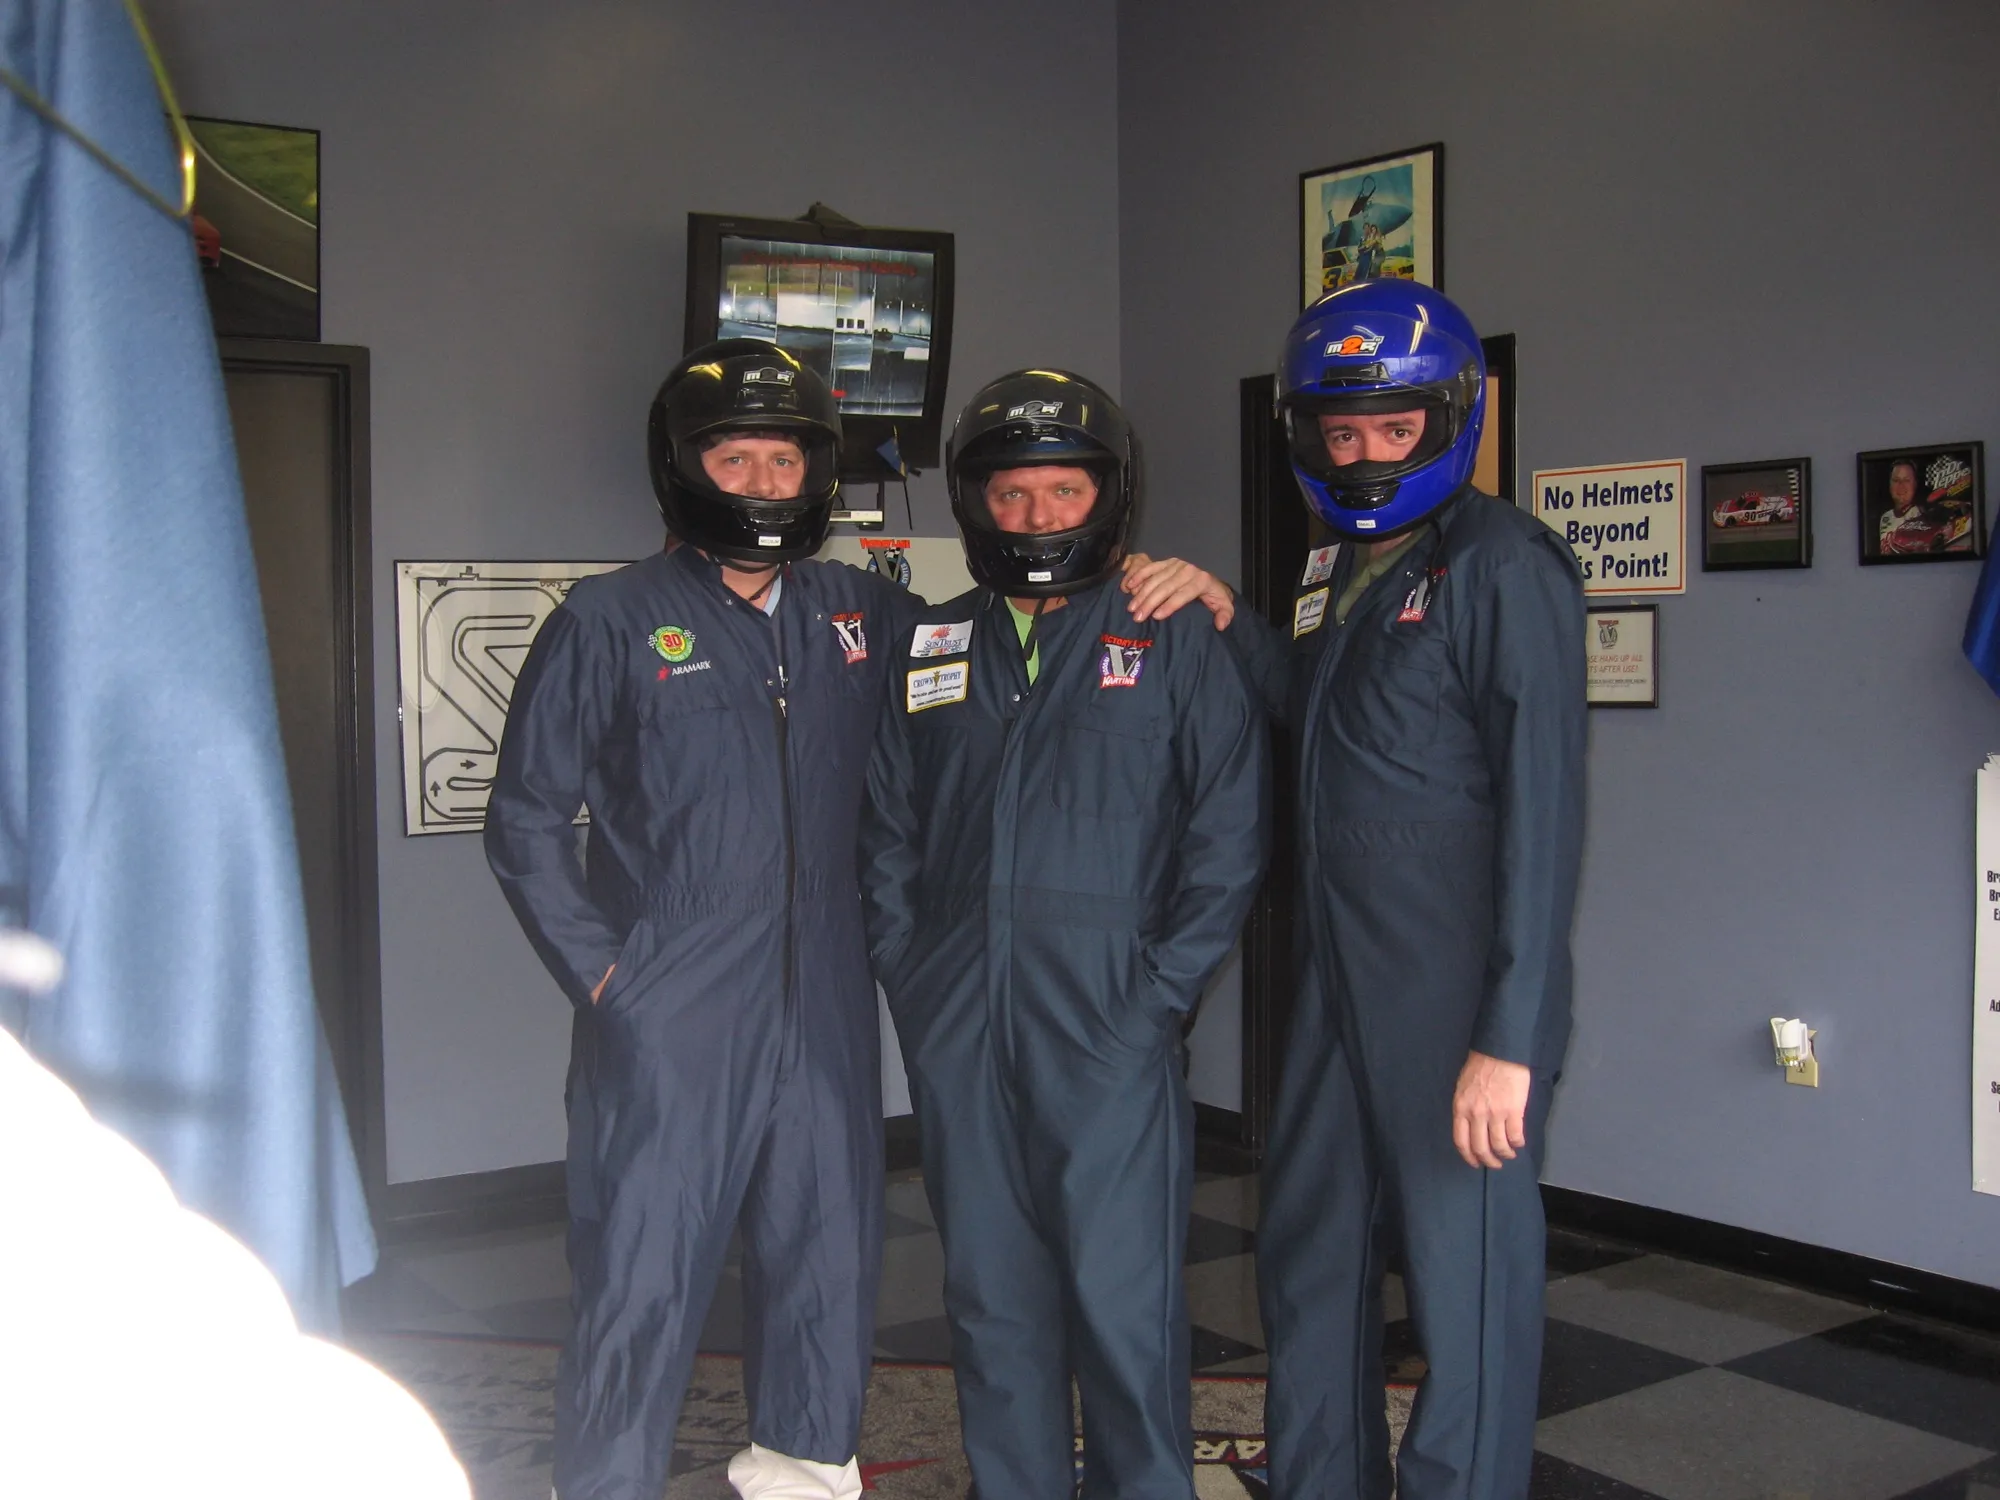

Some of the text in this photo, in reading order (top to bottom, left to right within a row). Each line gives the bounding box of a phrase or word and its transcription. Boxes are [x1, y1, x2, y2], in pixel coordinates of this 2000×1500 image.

[1544, 480, 1674, 510] No Helmets
[1566, 516, 1650, 551] Beyond
[1577, 552, 1668, 580] is Point!
[662, 633, 683, 648] 30
[671, 660, 712, 676] ARAMARK
[1102, 675, 1136, 687] KARTING
